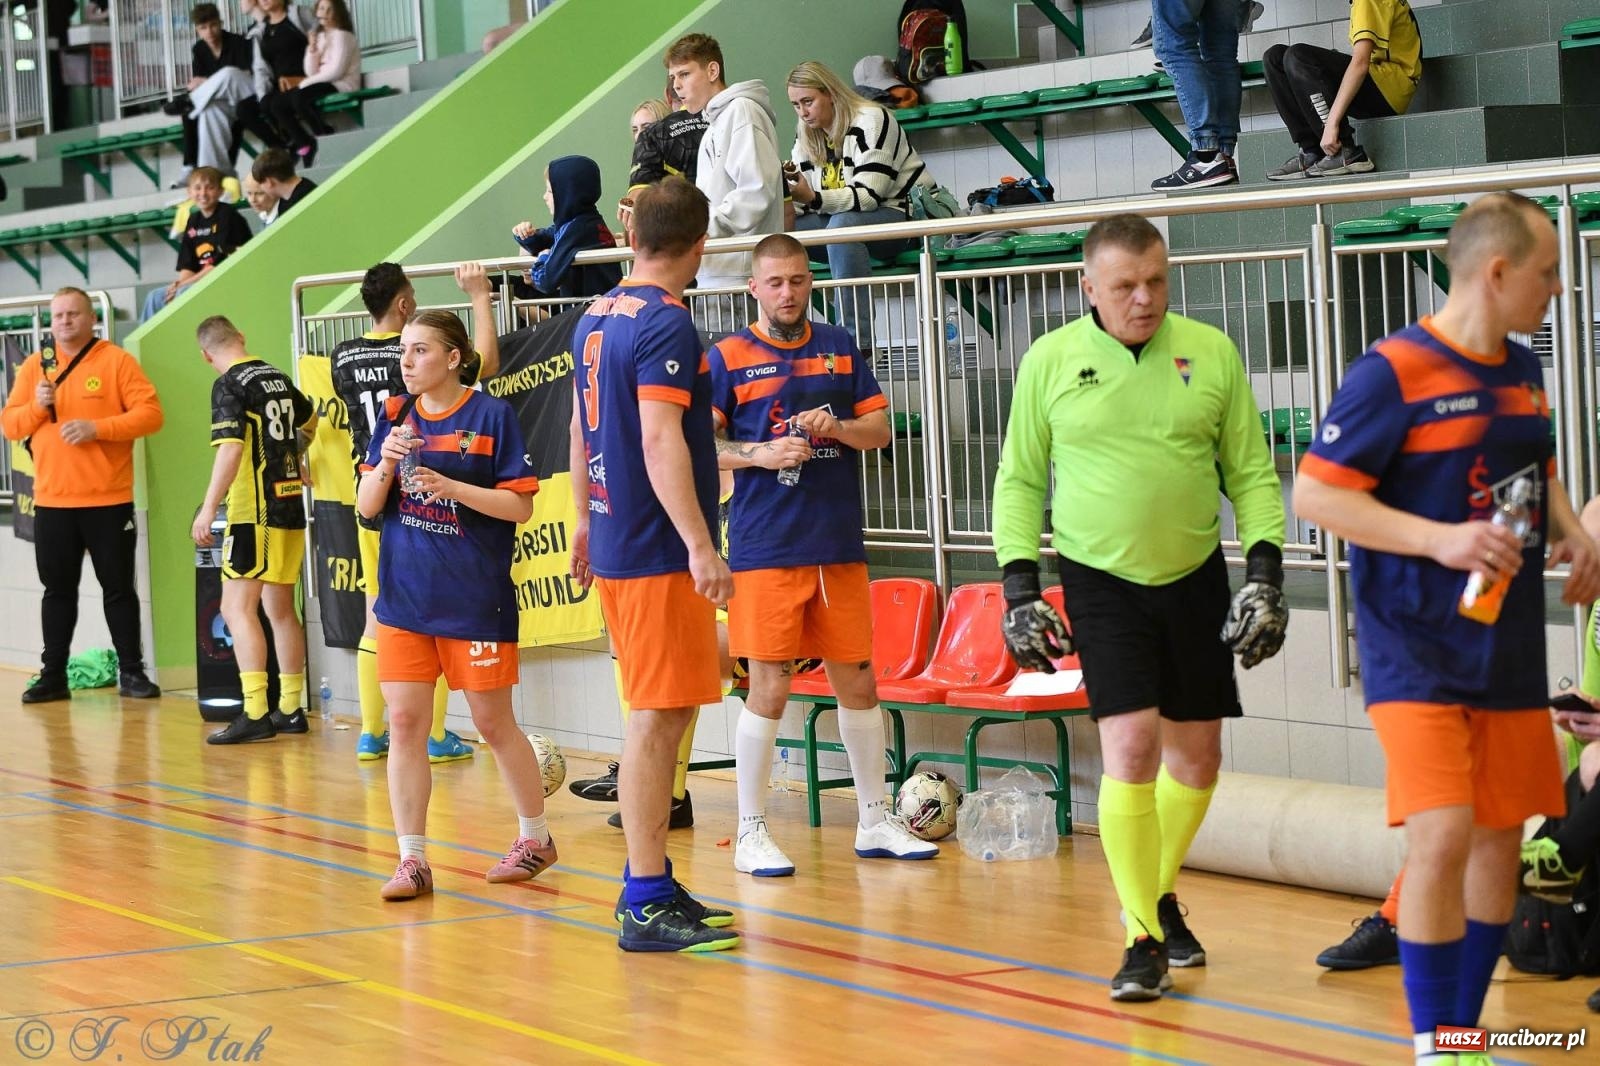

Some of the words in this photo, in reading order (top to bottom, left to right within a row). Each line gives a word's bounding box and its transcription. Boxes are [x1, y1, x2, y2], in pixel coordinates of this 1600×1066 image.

[354, 366, 389, 383] MATI
[487, 351, 575, 398] STOWARZYSZEN
[754, 366, 777, 376] VIGO
[261, 379, 288, 393] DADI
[583, 331, 604, 431] 3
[266, 398, 295, 441] 87
[867, 800, 886, 809] KIP
